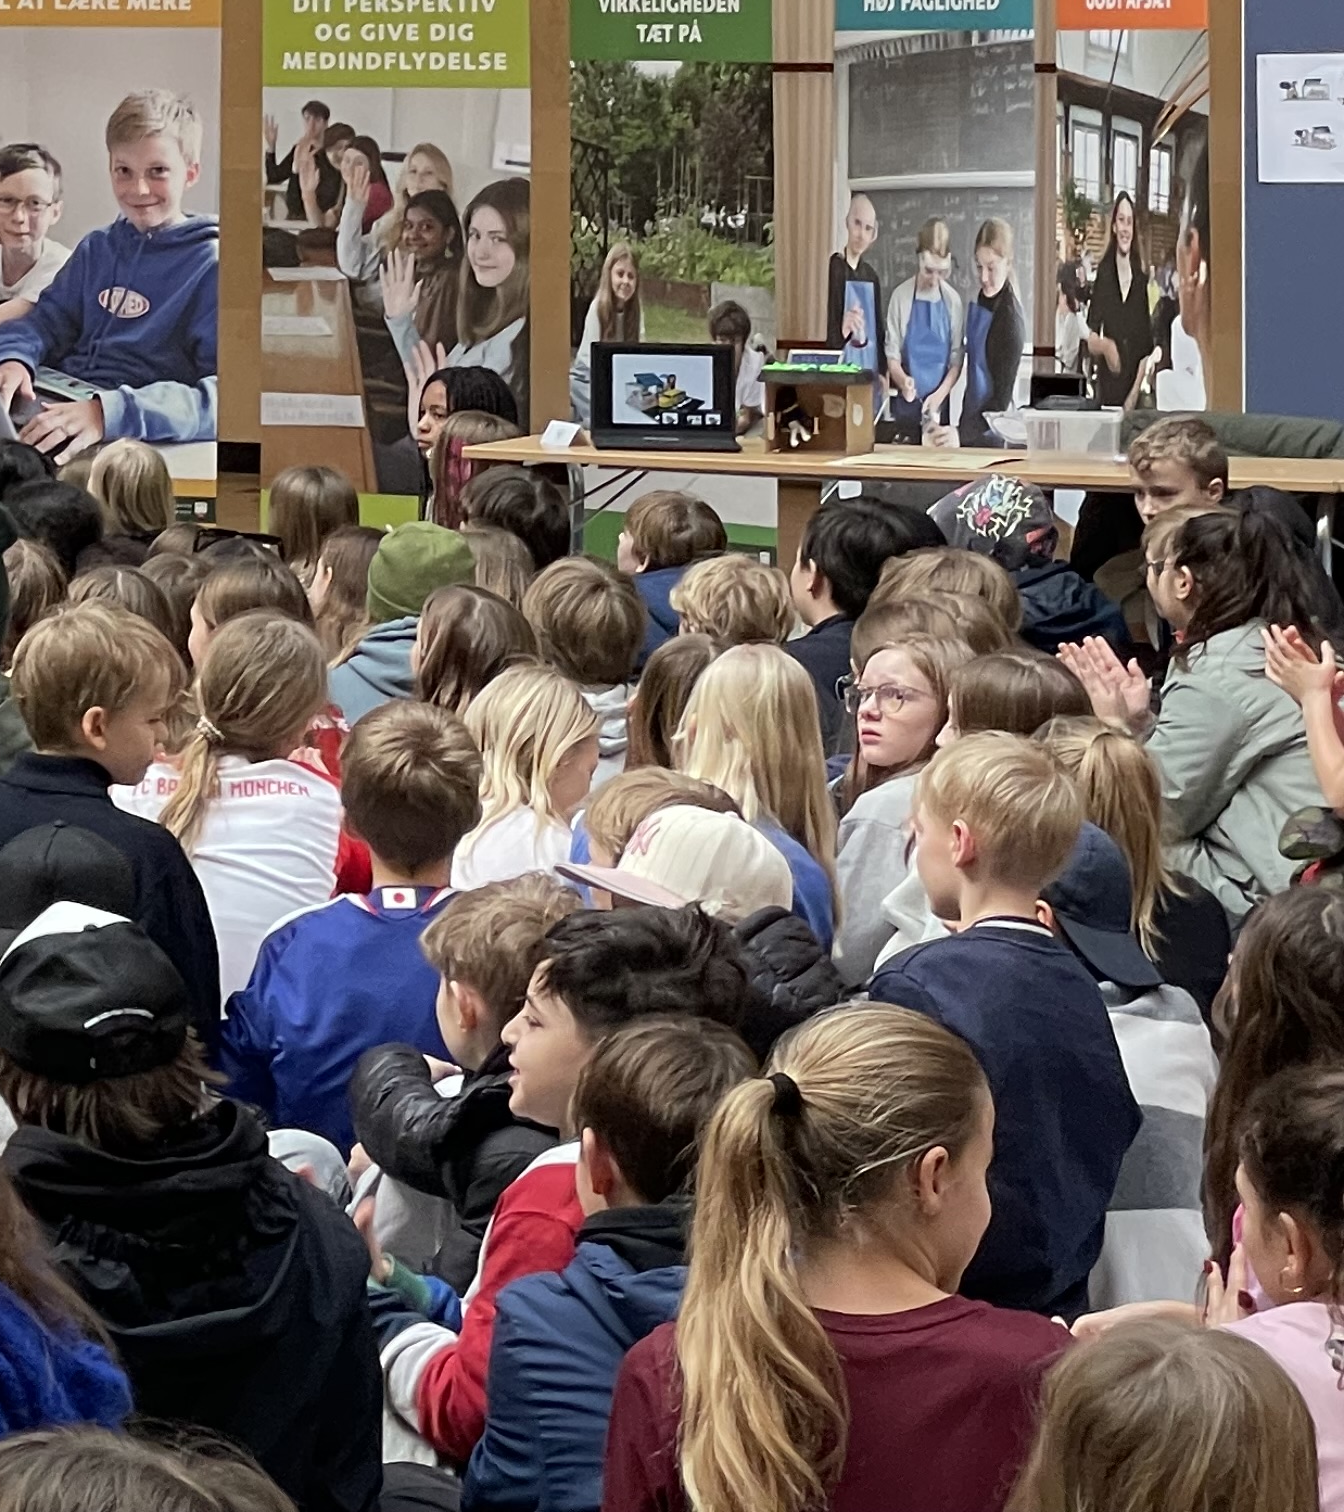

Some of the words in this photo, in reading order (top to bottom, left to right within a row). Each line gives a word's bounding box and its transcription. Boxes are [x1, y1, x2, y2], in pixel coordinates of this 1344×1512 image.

[314, 23, 351, 42] OG
[360, 23, 419, 42] GIVE
[430, 23, 474, 42] DIG
[636, 23, 674, 43] TÆT
[678, 18, 702, 43] PÅ
[282, 52, 507, 71] MEDINDFLYDELSE
